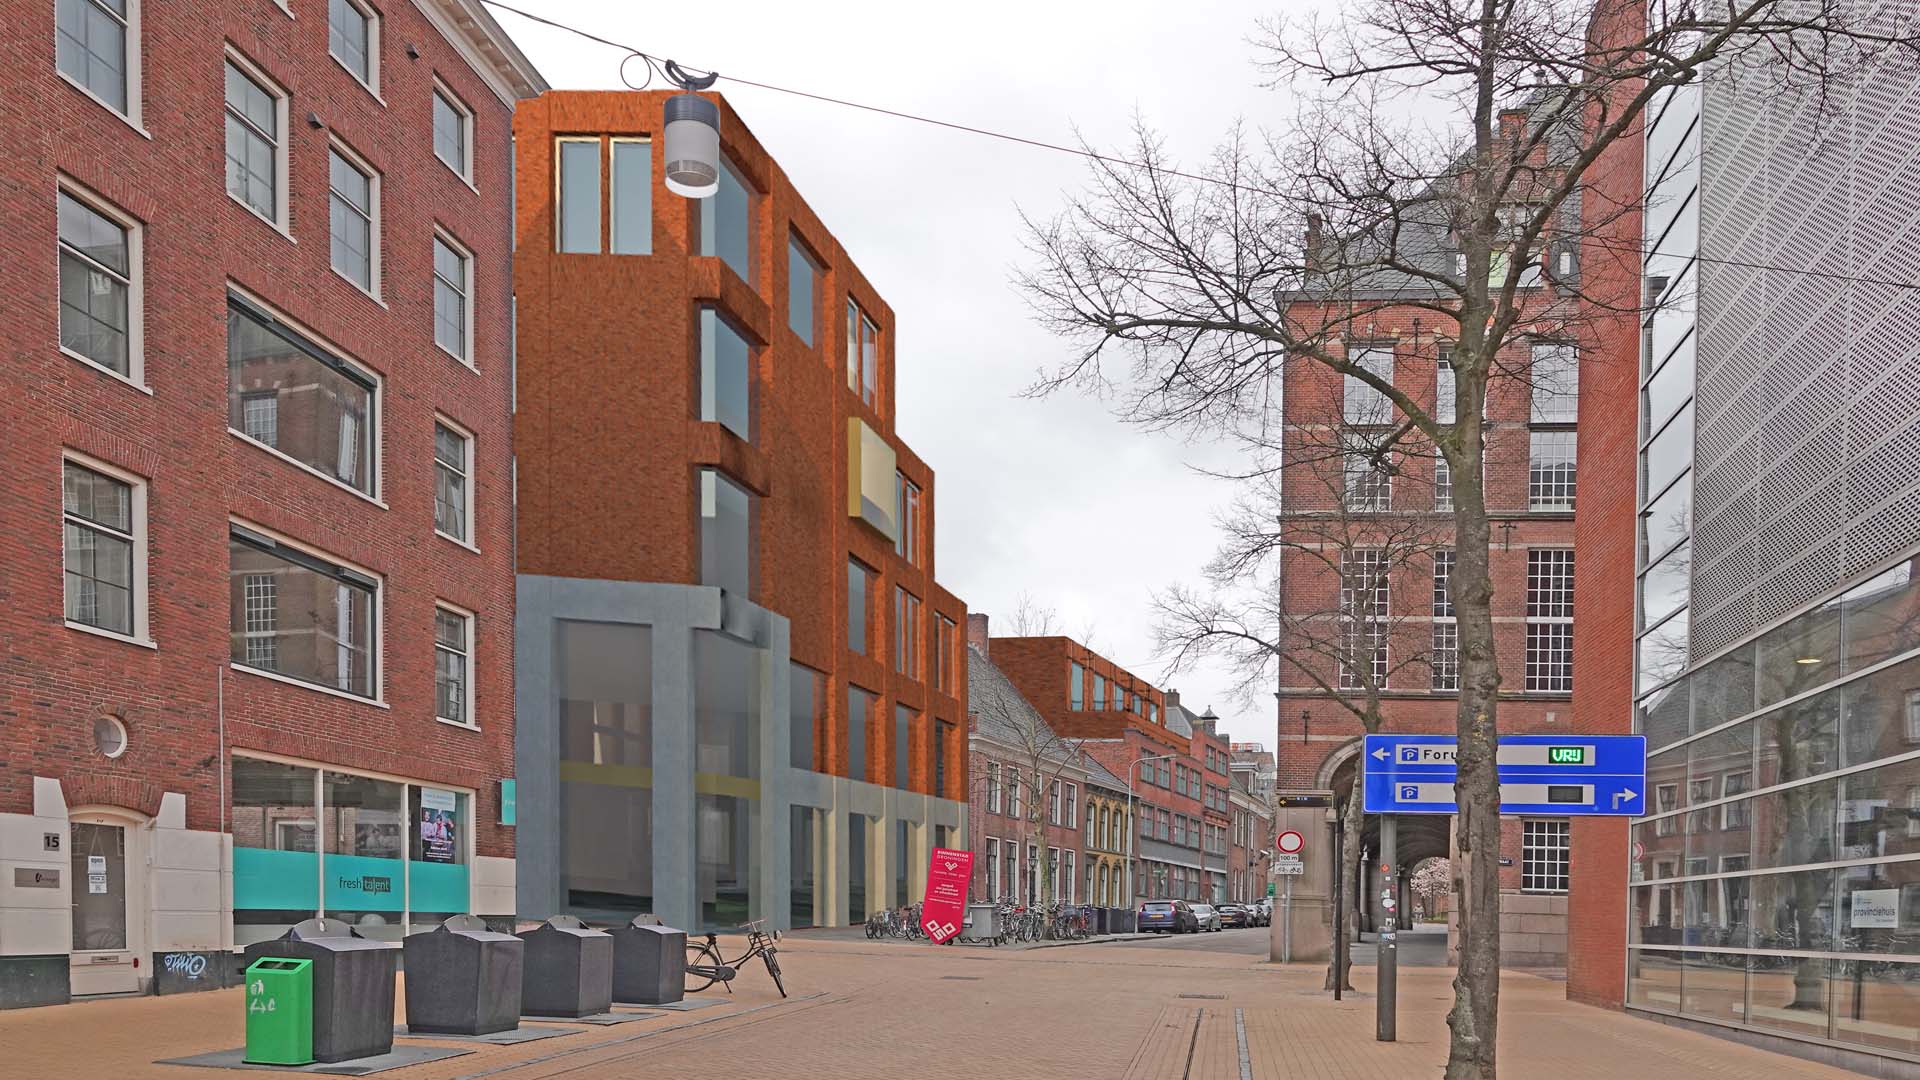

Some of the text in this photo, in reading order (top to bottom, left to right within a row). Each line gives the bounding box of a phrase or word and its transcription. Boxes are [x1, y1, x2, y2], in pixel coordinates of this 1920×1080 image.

[1552, 749, 1581, 762] VRIJ
[44, 835, 60, 848] 15
[339, 876, 391, 896] fresh talent
